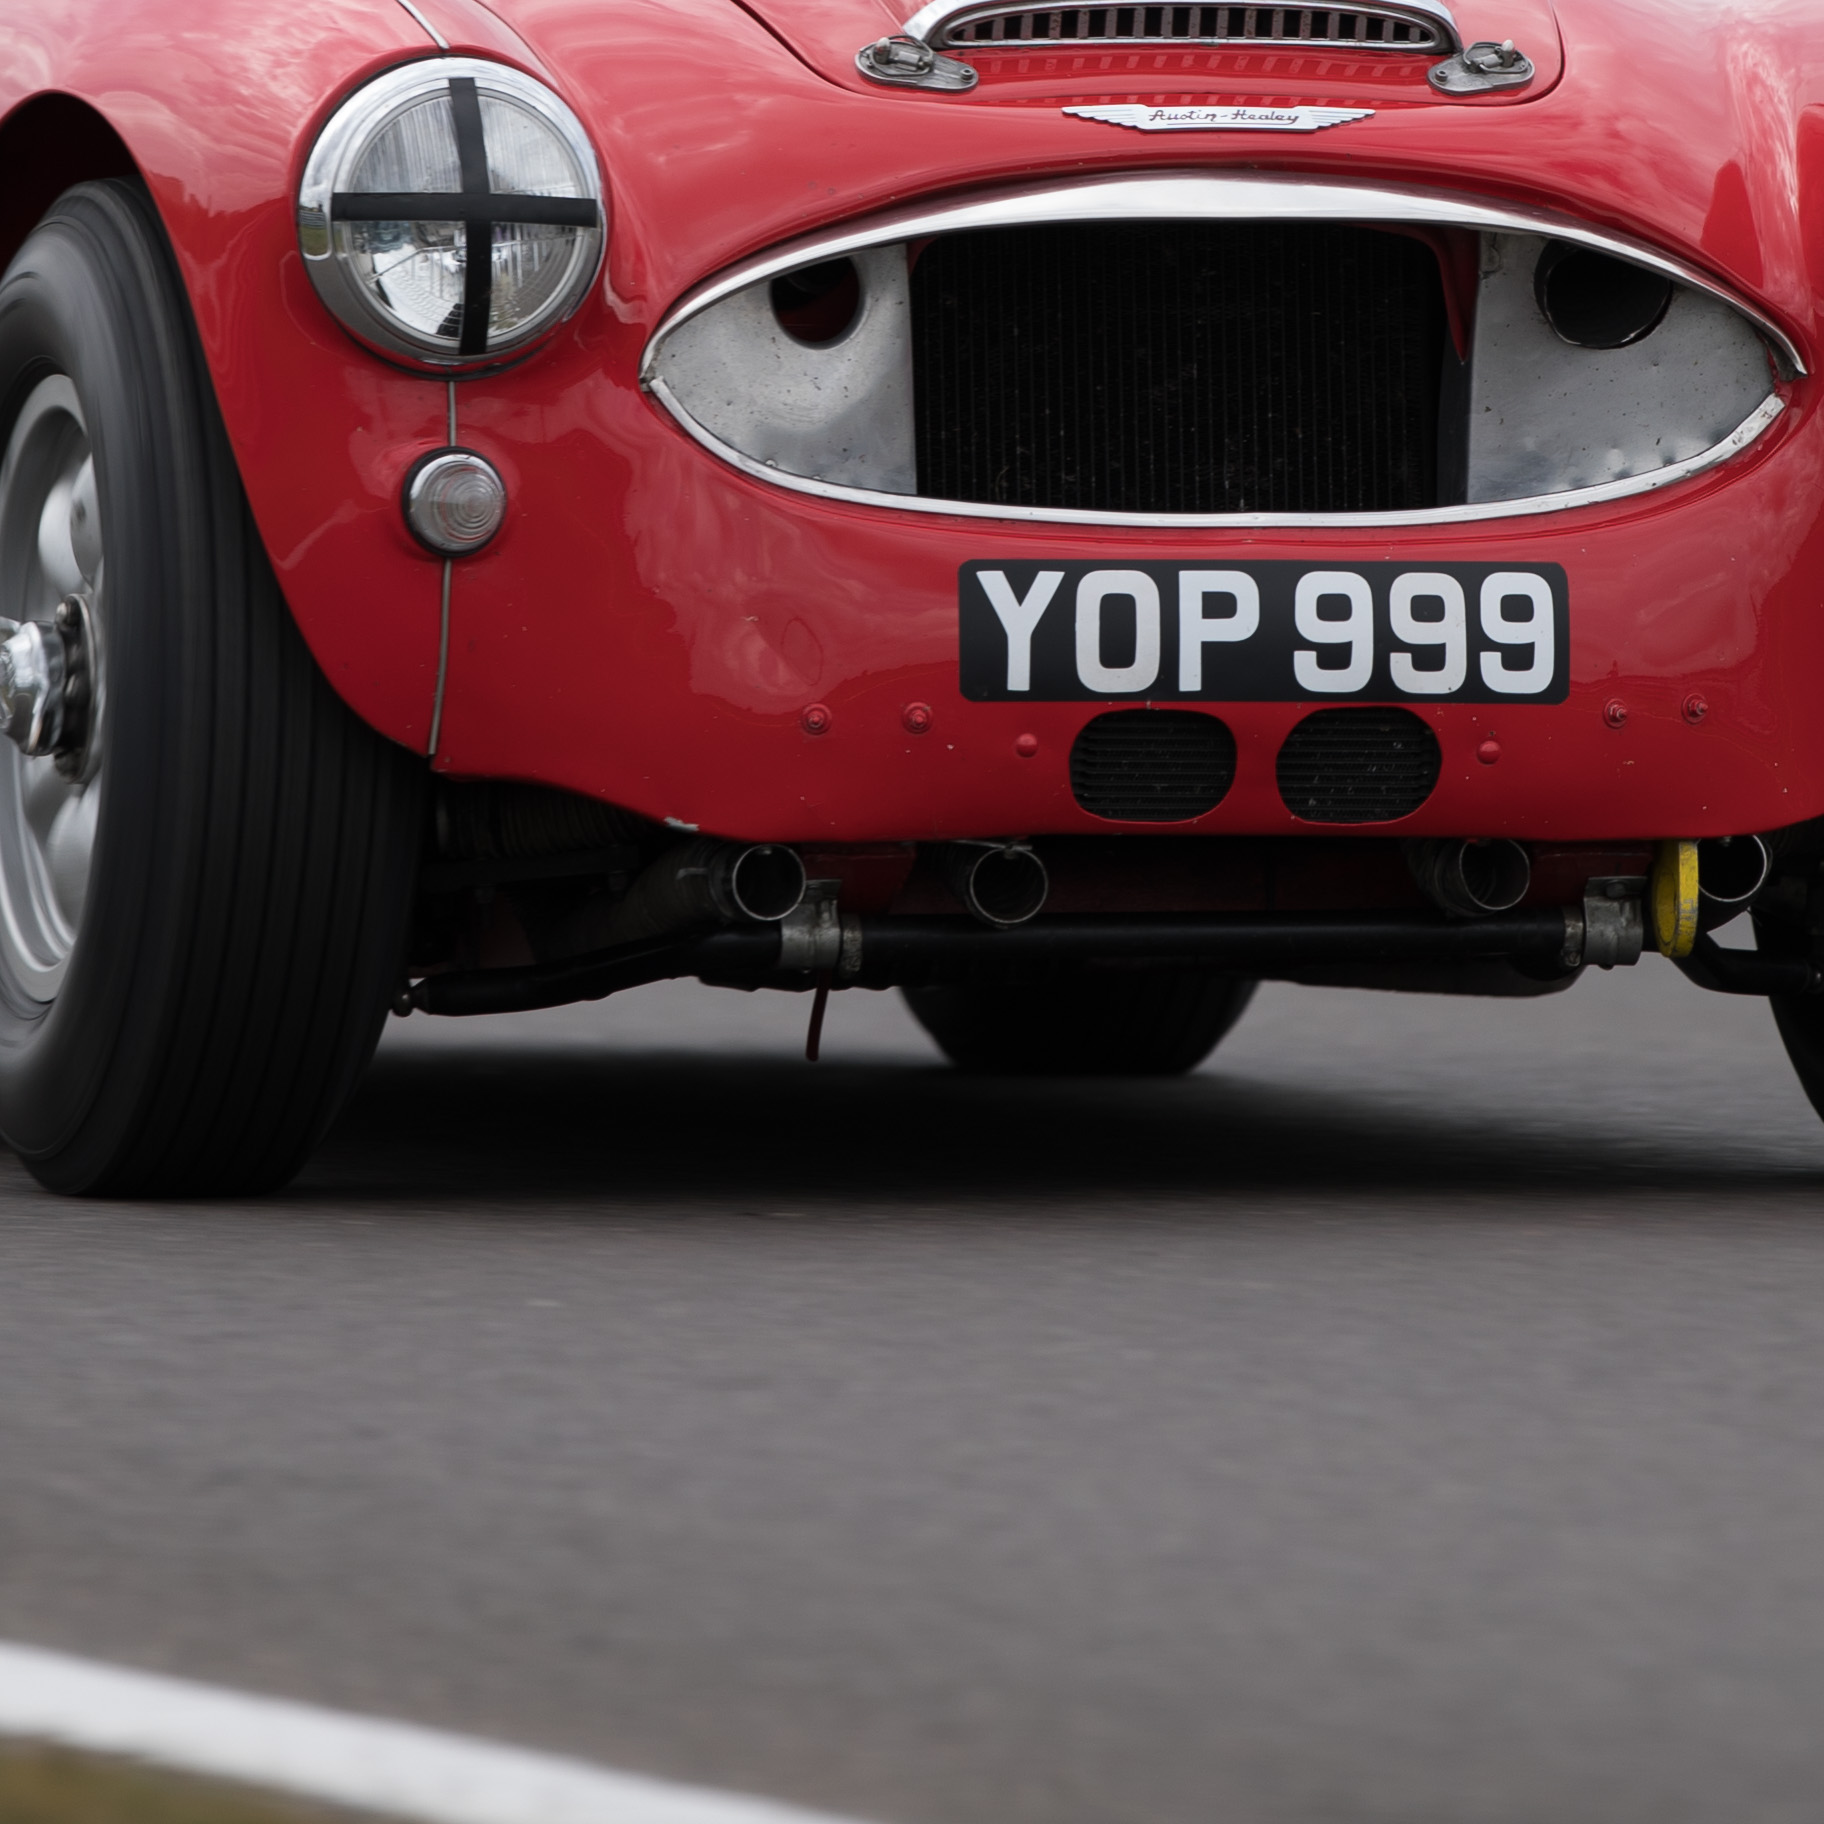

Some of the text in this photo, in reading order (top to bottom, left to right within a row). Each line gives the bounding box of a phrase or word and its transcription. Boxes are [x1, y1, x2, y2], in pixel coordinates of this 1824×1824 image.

[1149, 109, 1299, 124] Austin-Healey
[977, 570, 1555, 694] YOP 999
